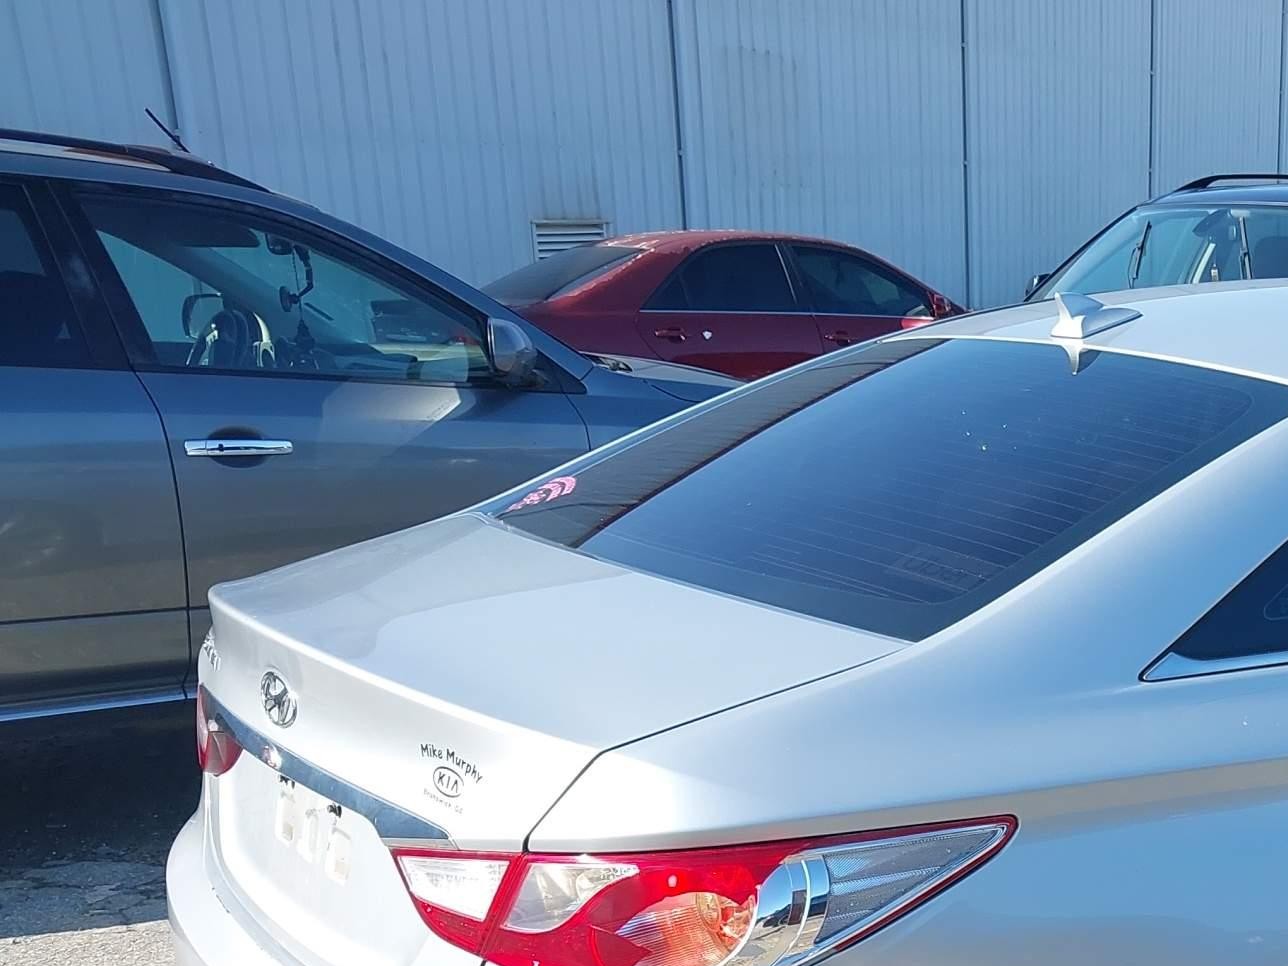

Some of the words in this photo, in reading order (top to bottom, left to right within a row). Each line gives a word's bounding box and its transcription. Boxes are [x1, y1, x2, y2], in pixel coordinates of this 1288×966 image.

[420, 743, 443, 760] Mike
[446, 748, 483, 784] Murphy
[437, 771, 458, 794] KIA
